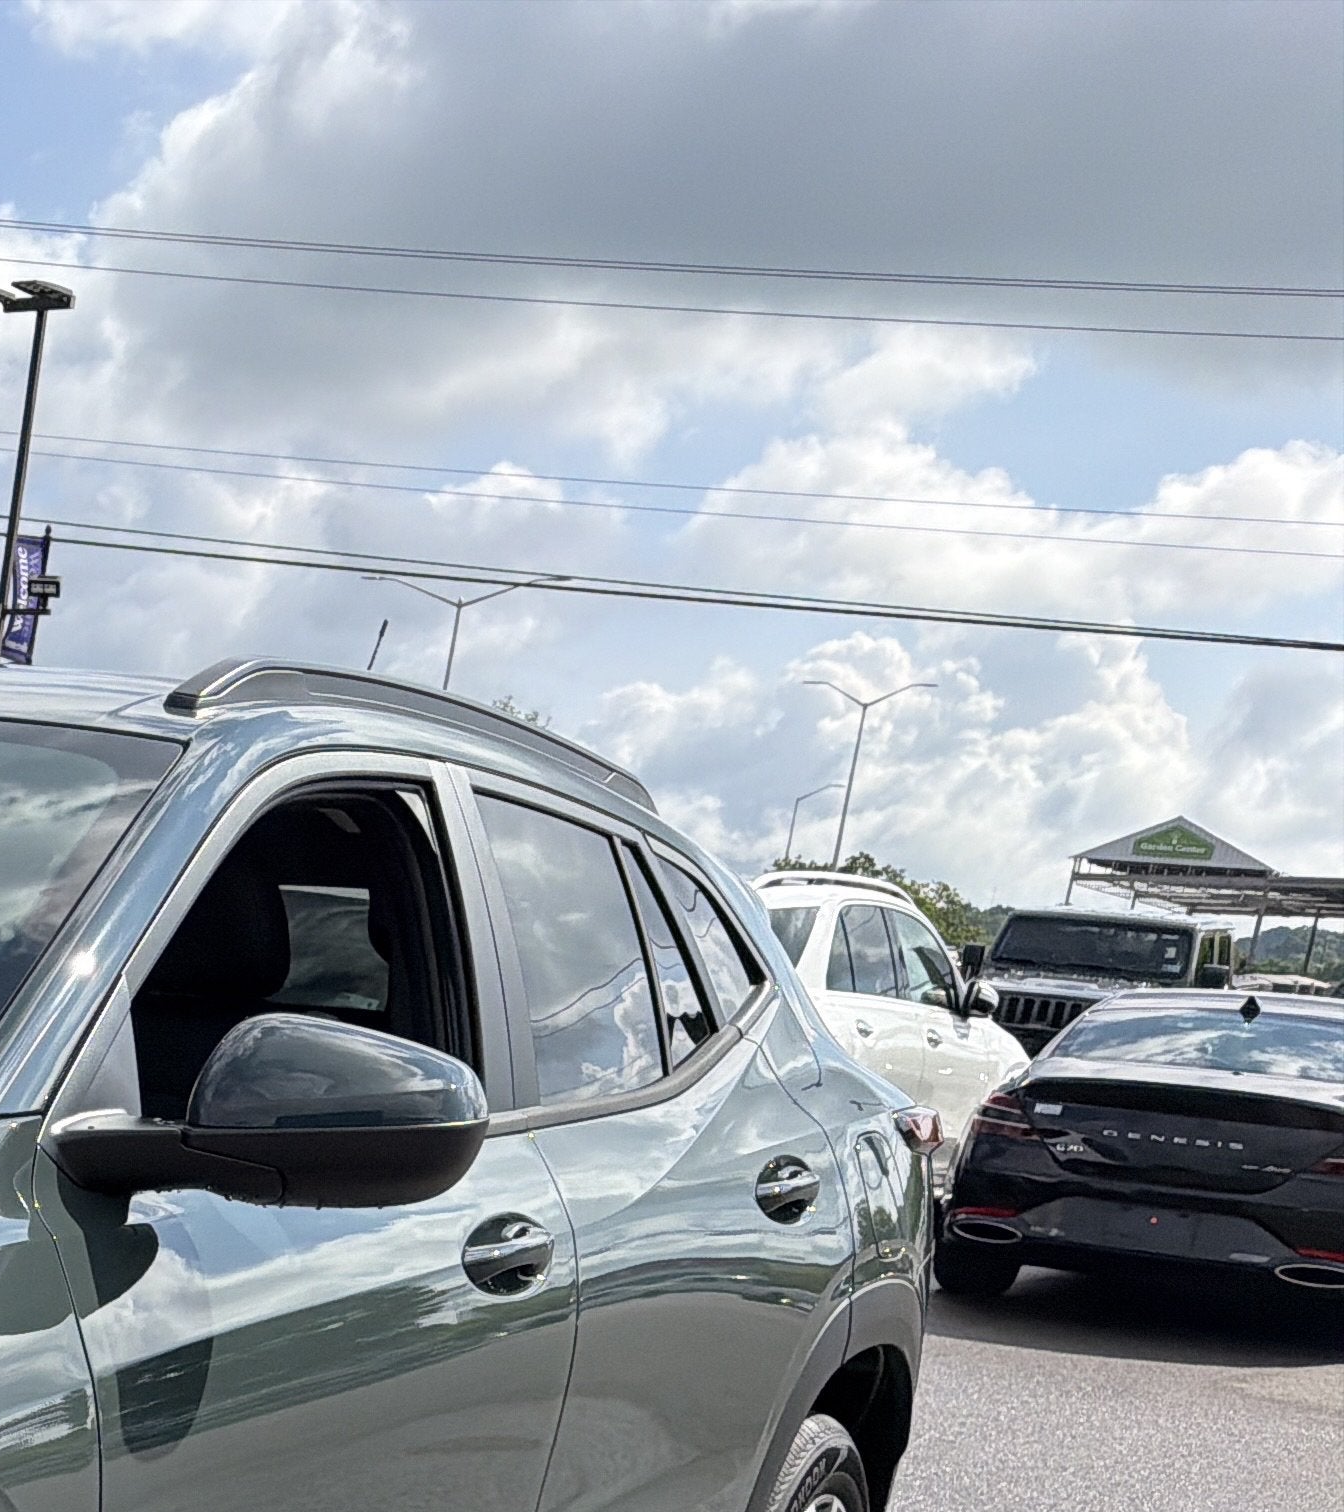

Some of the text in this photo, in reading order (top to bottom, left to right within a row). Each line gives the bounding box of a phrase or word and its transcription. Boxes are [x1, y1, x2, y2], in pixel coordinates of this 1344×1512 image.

[1140, 843, 1207, 854] Garden Center
[1102, 1129, 1244, 1150] GENESIS
